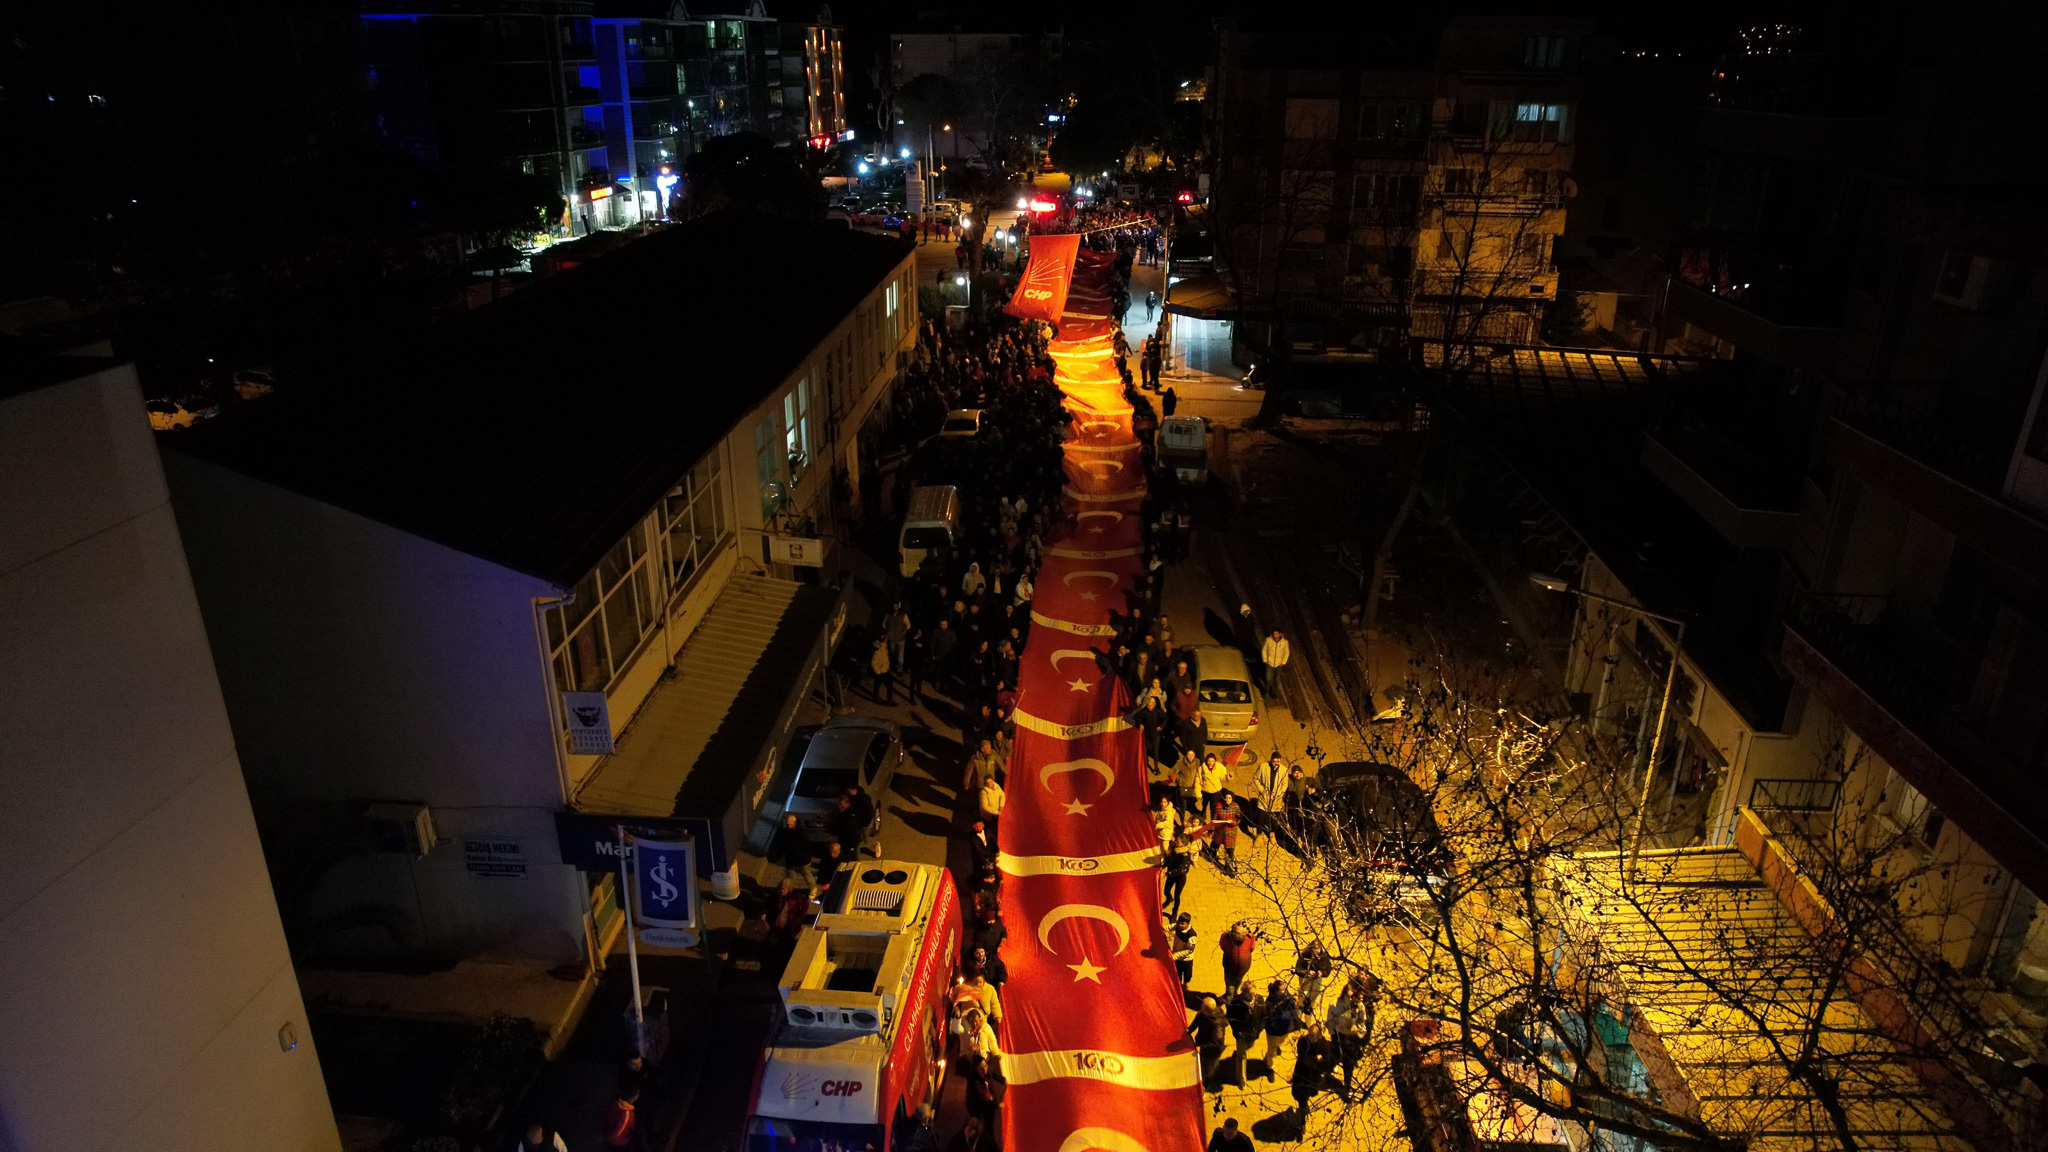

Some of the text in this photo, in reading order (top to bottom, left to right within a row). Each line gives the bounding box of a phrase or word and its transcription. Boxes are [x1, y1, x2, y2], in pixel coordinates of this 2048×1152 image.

[1024, 289, 1053, 301] CHP
[926, 924, 942, 963] HALK
[821, 1079, 863, 1097] CHP
